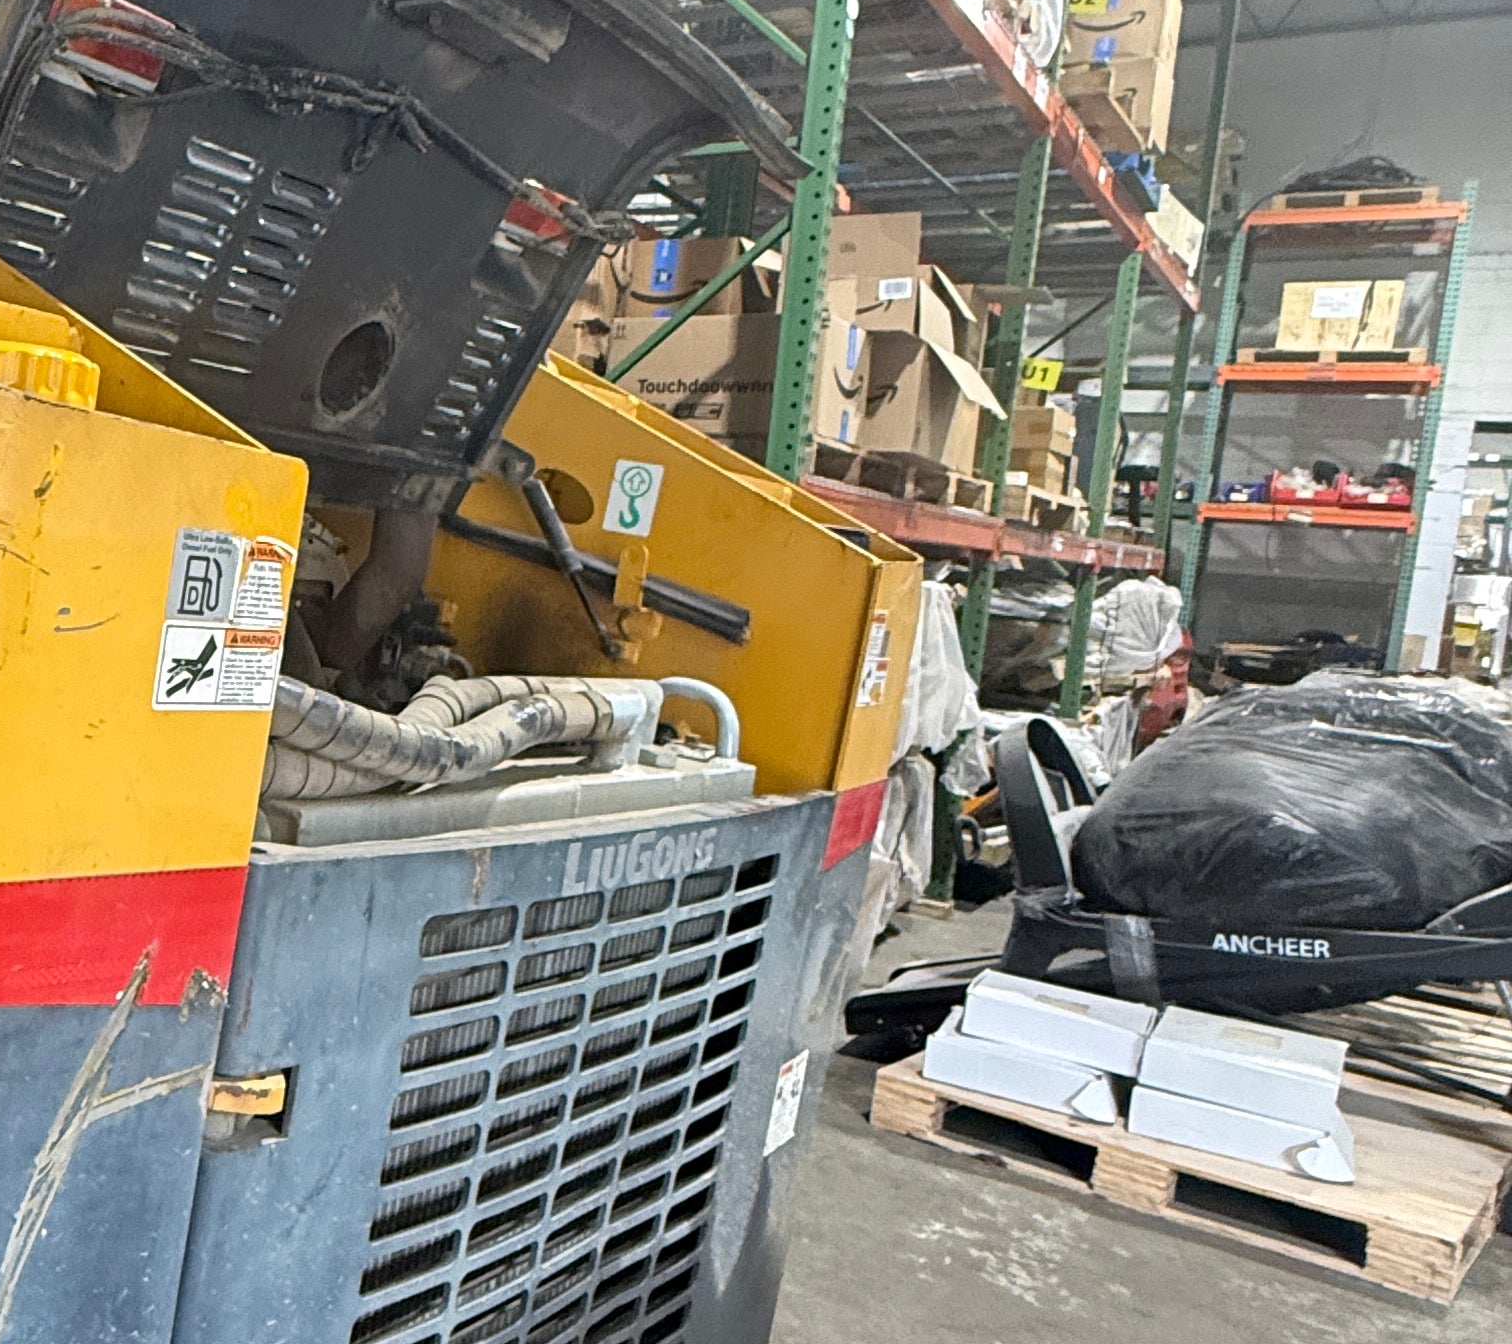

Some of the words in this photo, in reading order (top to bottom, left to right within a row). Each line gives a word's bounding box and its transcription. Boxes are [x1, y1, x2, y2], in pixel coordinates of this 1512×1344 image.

[1021, 364, 1049, 383] U1
[239, 634, 275, 645] WARNING
[1212, 933, 1330, 958] ANCHEER
